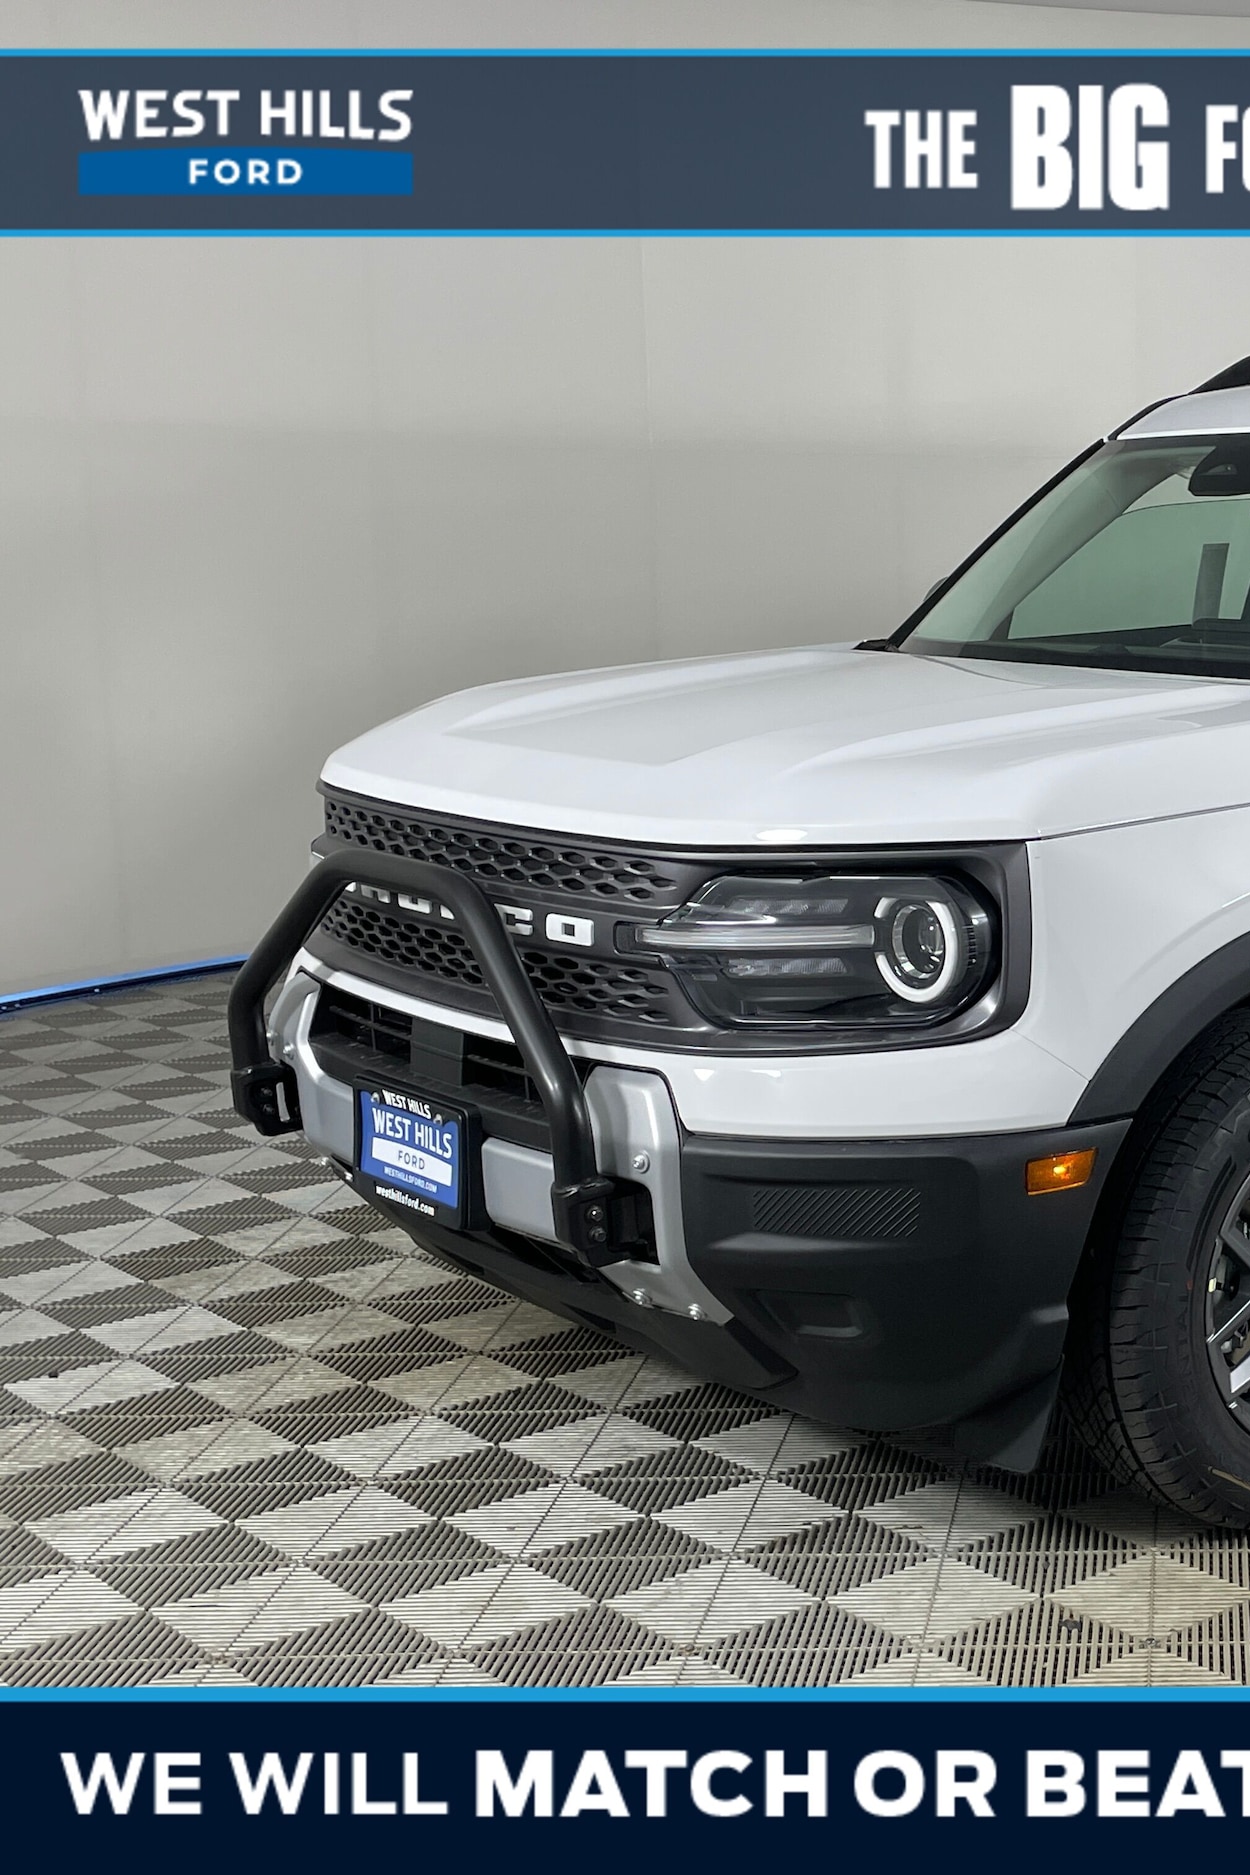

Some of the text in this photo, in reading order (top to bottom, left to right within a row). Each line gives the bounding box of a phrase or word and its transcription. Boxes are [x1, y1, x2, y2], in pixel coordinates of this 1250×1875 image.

[382, 1089, 431, 1120] WEST HILLS
[372, 1107, 452, 1159] WEST HILLS
[398, 1150, 425, 1170] FORD
[375, 1185, 434, 1216] westhillsford.com
